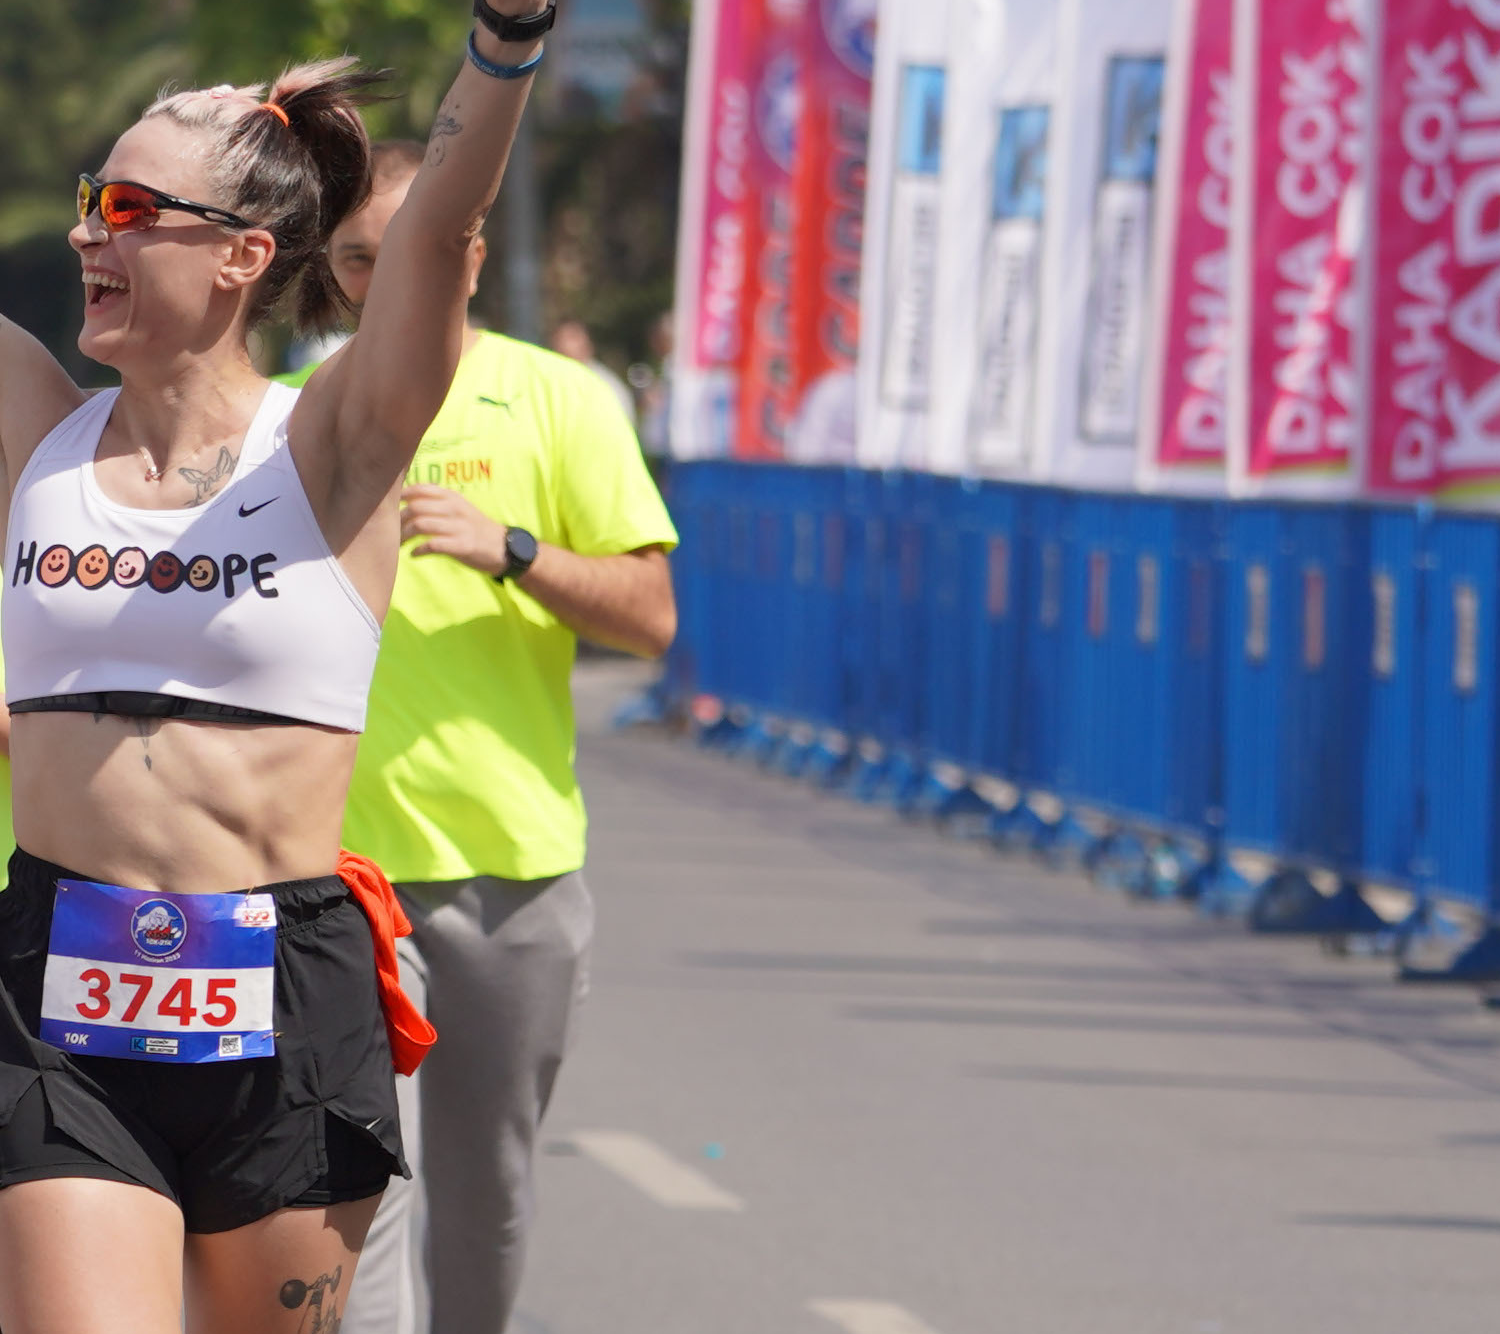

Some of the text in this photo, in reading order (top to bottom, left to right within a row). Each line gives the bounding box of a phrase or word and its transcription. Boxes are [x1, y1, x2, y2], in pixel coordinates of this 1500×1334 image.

[1267, 233, 1331, 454] DAHA
[1391, 240, 1449, 482] DAHA
[64, 1032, 89, 1046] 10K
[76, 968, 237, 1027] 3745
